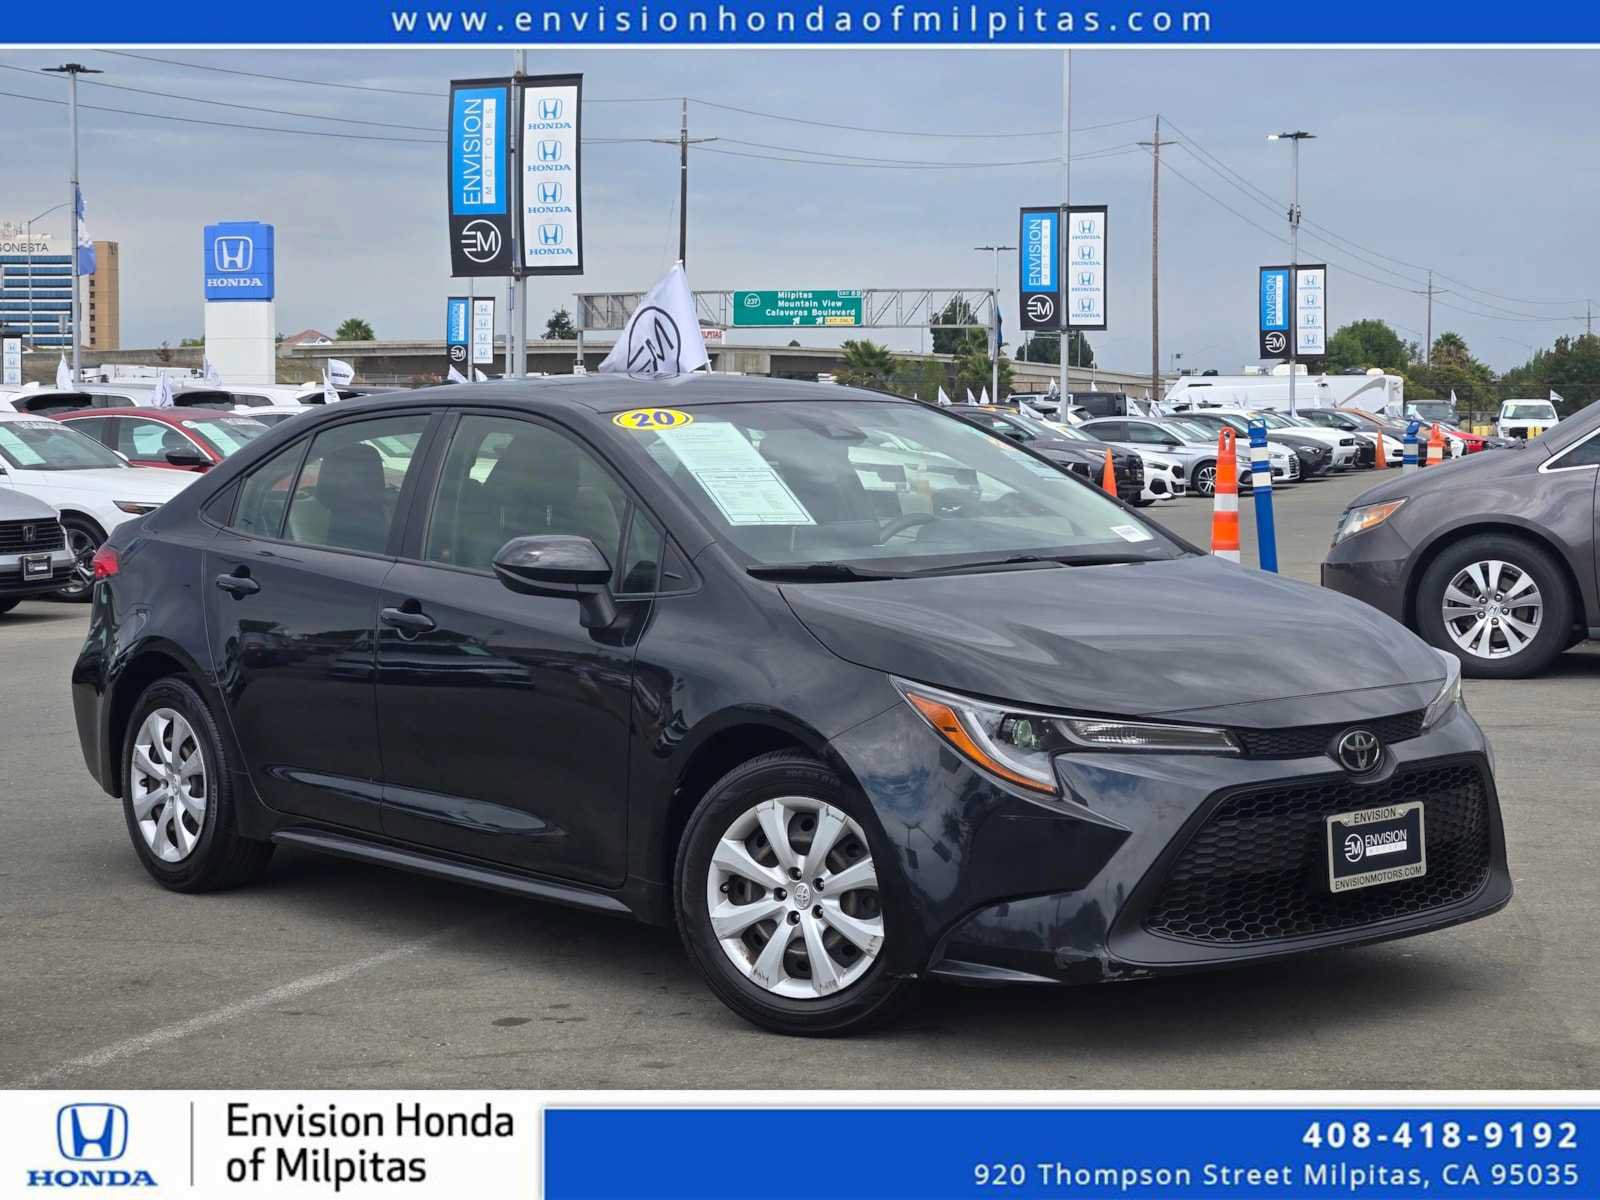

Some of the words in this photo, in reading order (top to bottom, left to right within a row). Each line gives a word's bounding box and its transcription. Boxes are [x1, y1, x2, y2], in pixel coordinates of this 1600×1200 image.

[528, 122, 572, 130] HONDA
[463, 99, 481, 205] ENVISION
[485, 106, 493, 195] MOTORS
[528, 164, 571, 172] HONDA
[528, 206, 572, 214] HONDA
[529, 248, 574, 256] HONDA
[1028, 219, 1041, 286] ENVISION
[207, 278, 263, 287] HONDA
[777, 291, 813, 300] Milpitas
[632, 411, 675, 427] 20
[1354, 808, 1396, 824] ENVISION
[1365, 829, 1407, 847] ENVISION
[1335, 866, 1422, 890] ENVISIONMOTORS.COM
